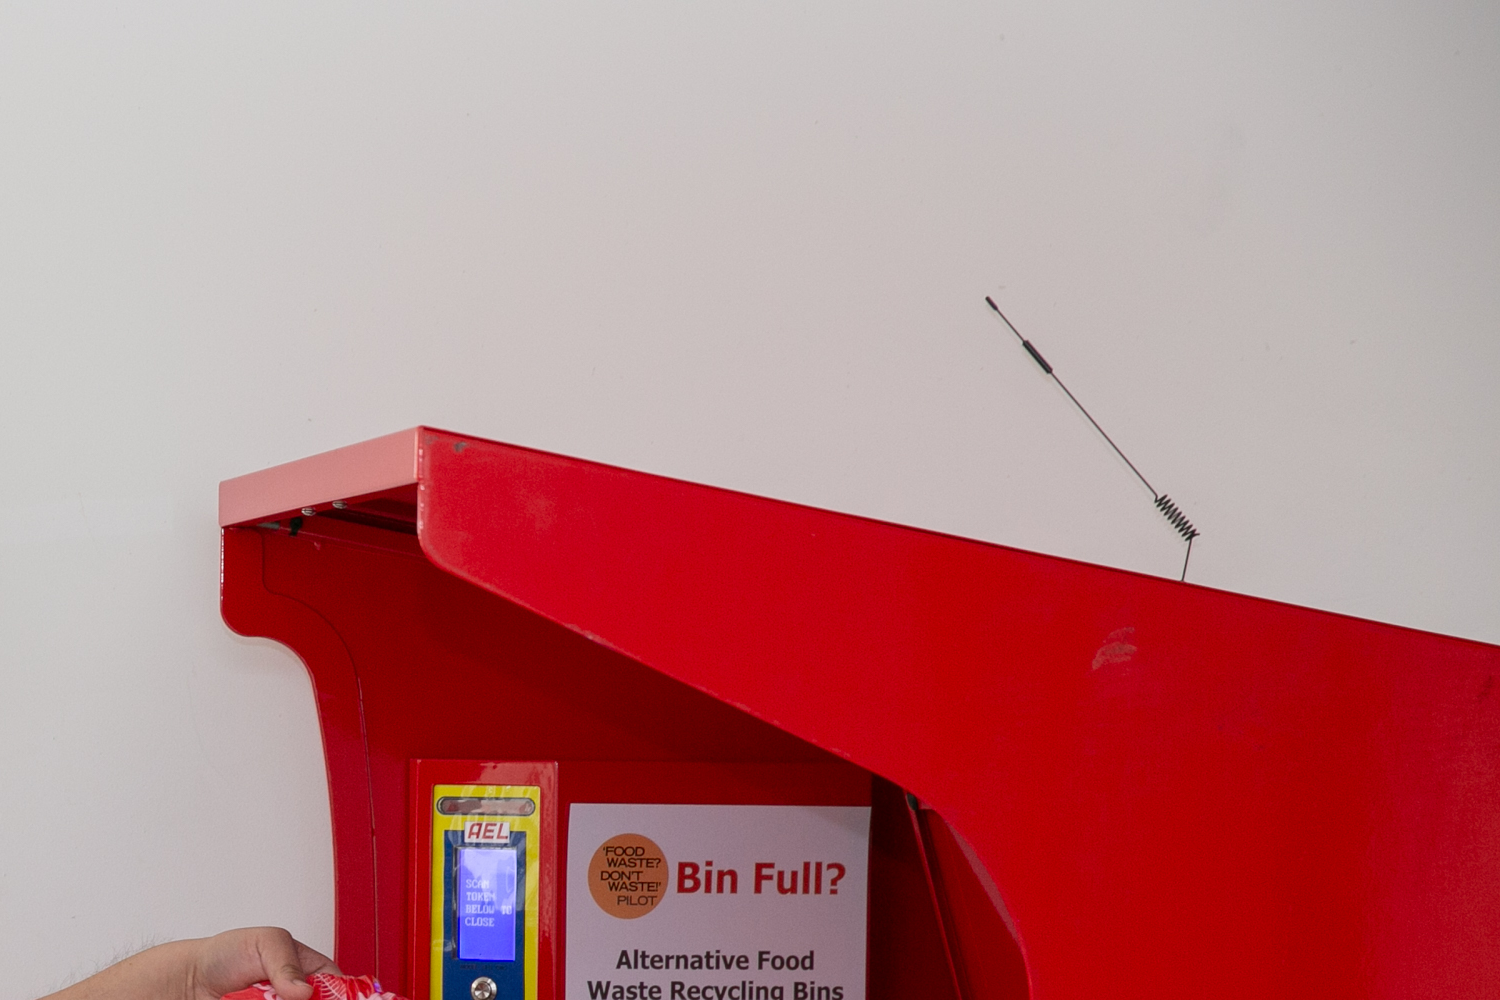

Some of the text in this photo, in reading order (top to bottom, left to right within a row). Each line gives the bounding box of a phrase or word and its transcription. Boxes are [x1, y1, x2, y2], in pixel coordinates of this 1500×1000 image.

[467, 822, 509, 840] AEL
[606, 857, 661, 868] WASTE?
[600, 870, 643, 881] DON'T
[677, 861, 845, 894] Bin Full?
[465, 879, 490, 889] SCAN
[466, 891, 496, 902] TOKEN
[617, 895, 657, 906] PILOT
[465, 904, 513, 915] BELOW TO
[464, 916, 495, 927] CLOSE
[616, 950, 814, 970] Alternative Food
[587, 981, 661, 1000] Waste
[794, 981, 843, 1000] Bins
